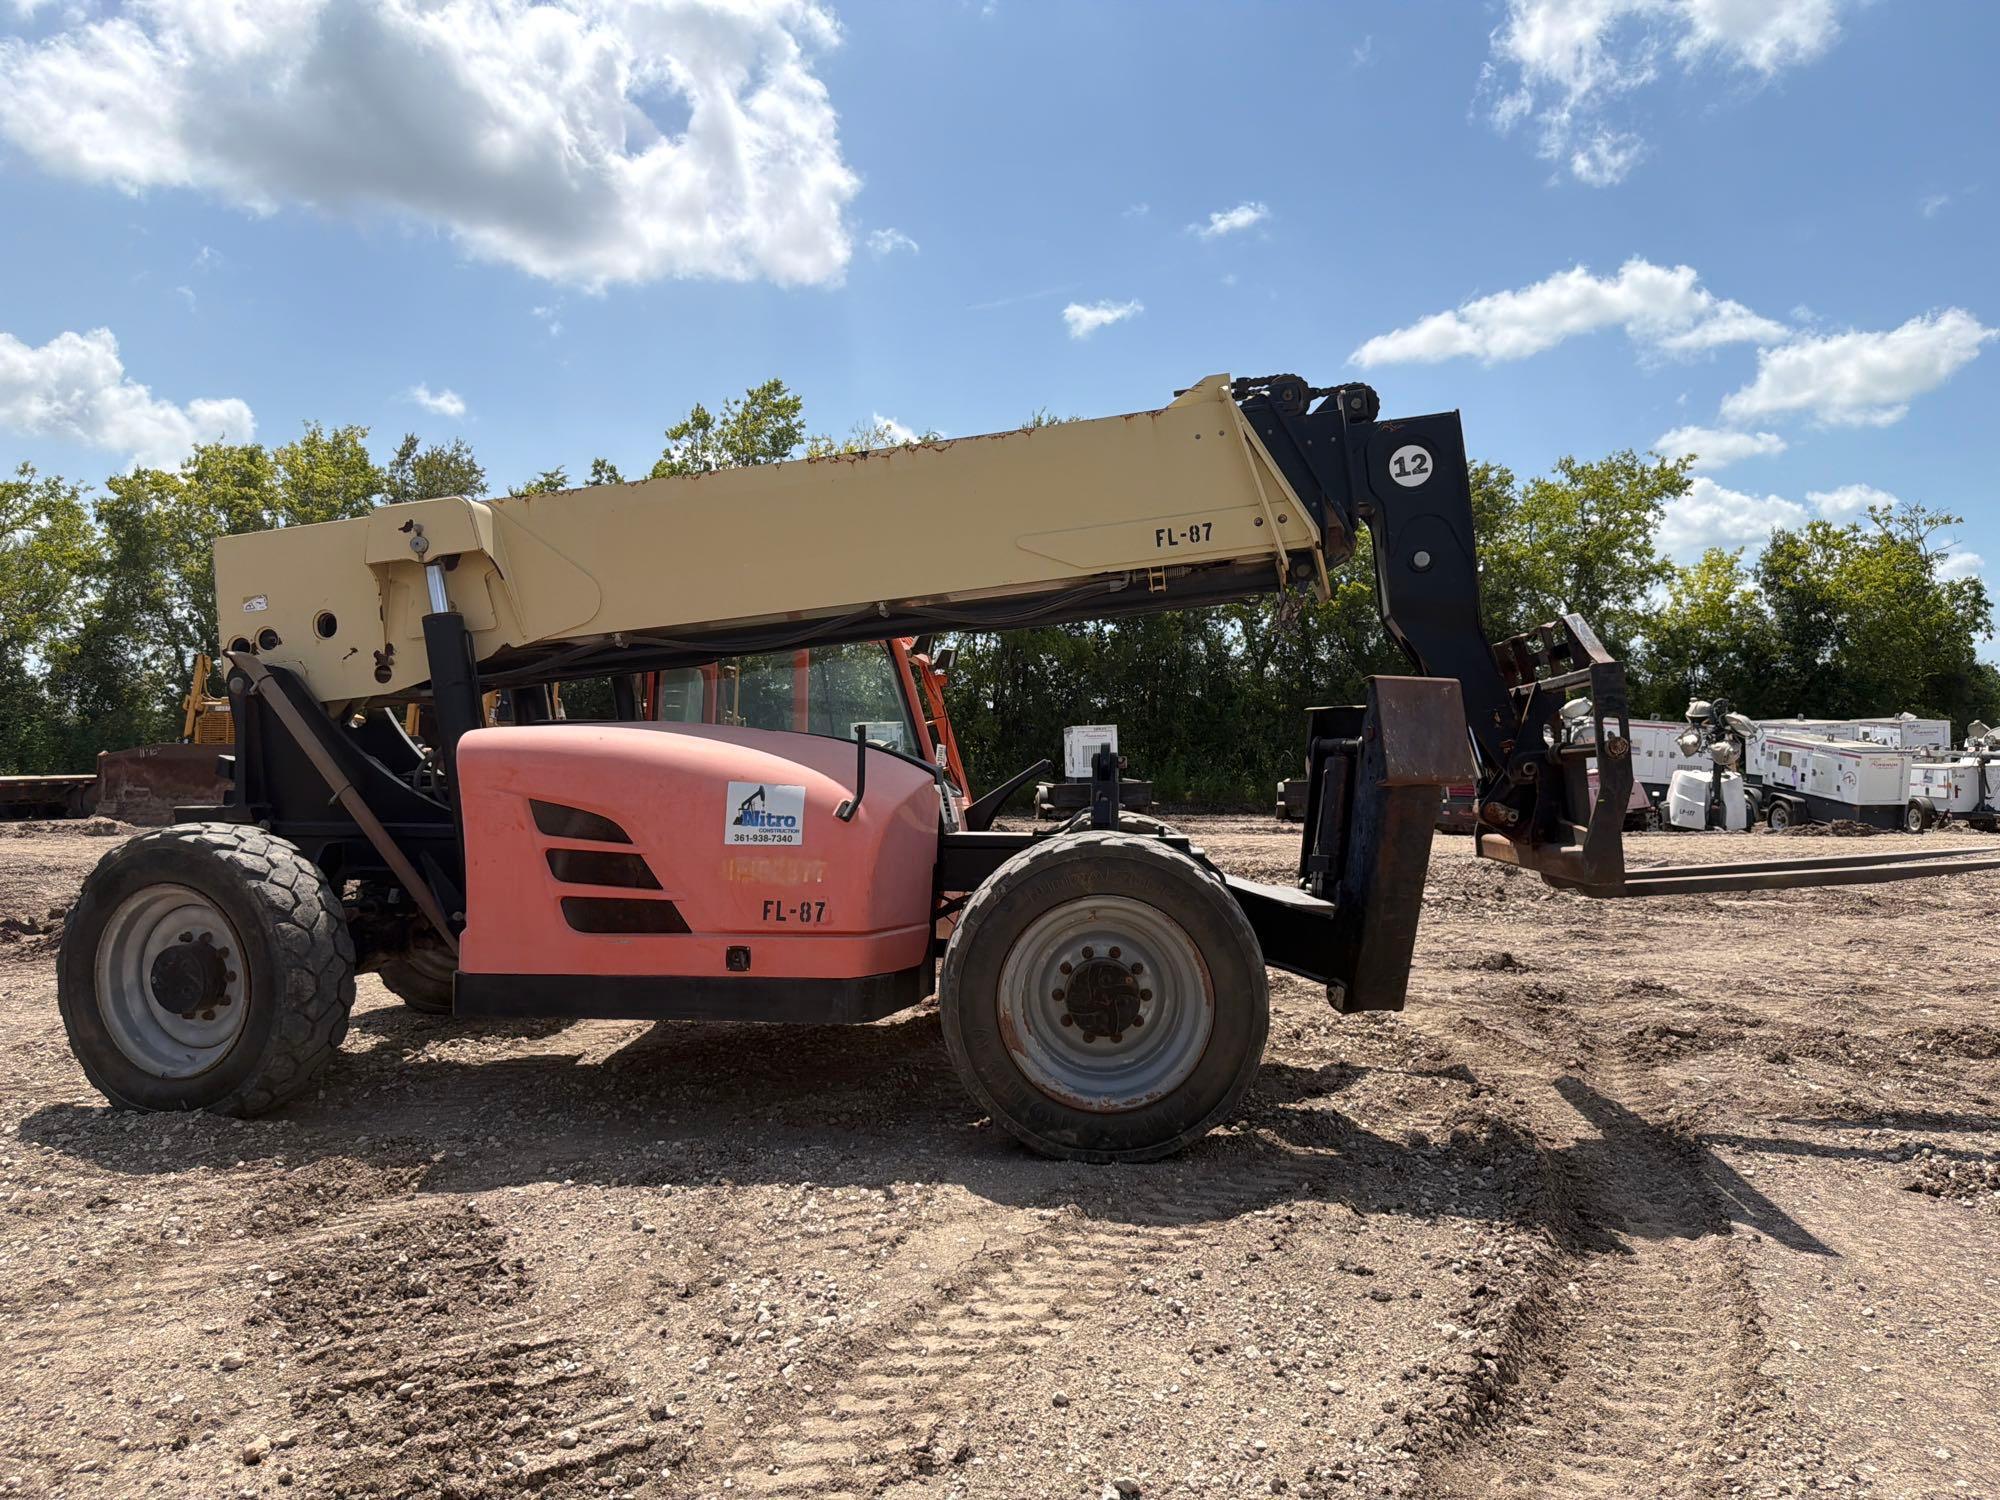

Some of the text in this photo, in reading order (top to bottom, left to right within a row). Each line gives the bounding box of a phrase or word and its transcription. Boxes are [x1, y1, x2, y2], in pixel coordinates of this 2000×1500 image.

[1393, 453, 1429, 478] 12
[1155, 522, 1213, 548] FL-87
[742, 809, 796, 827] Nitro
[734, 834, 793, 842] 361-938-7340
[763, 900, 826, 922] FL-87
